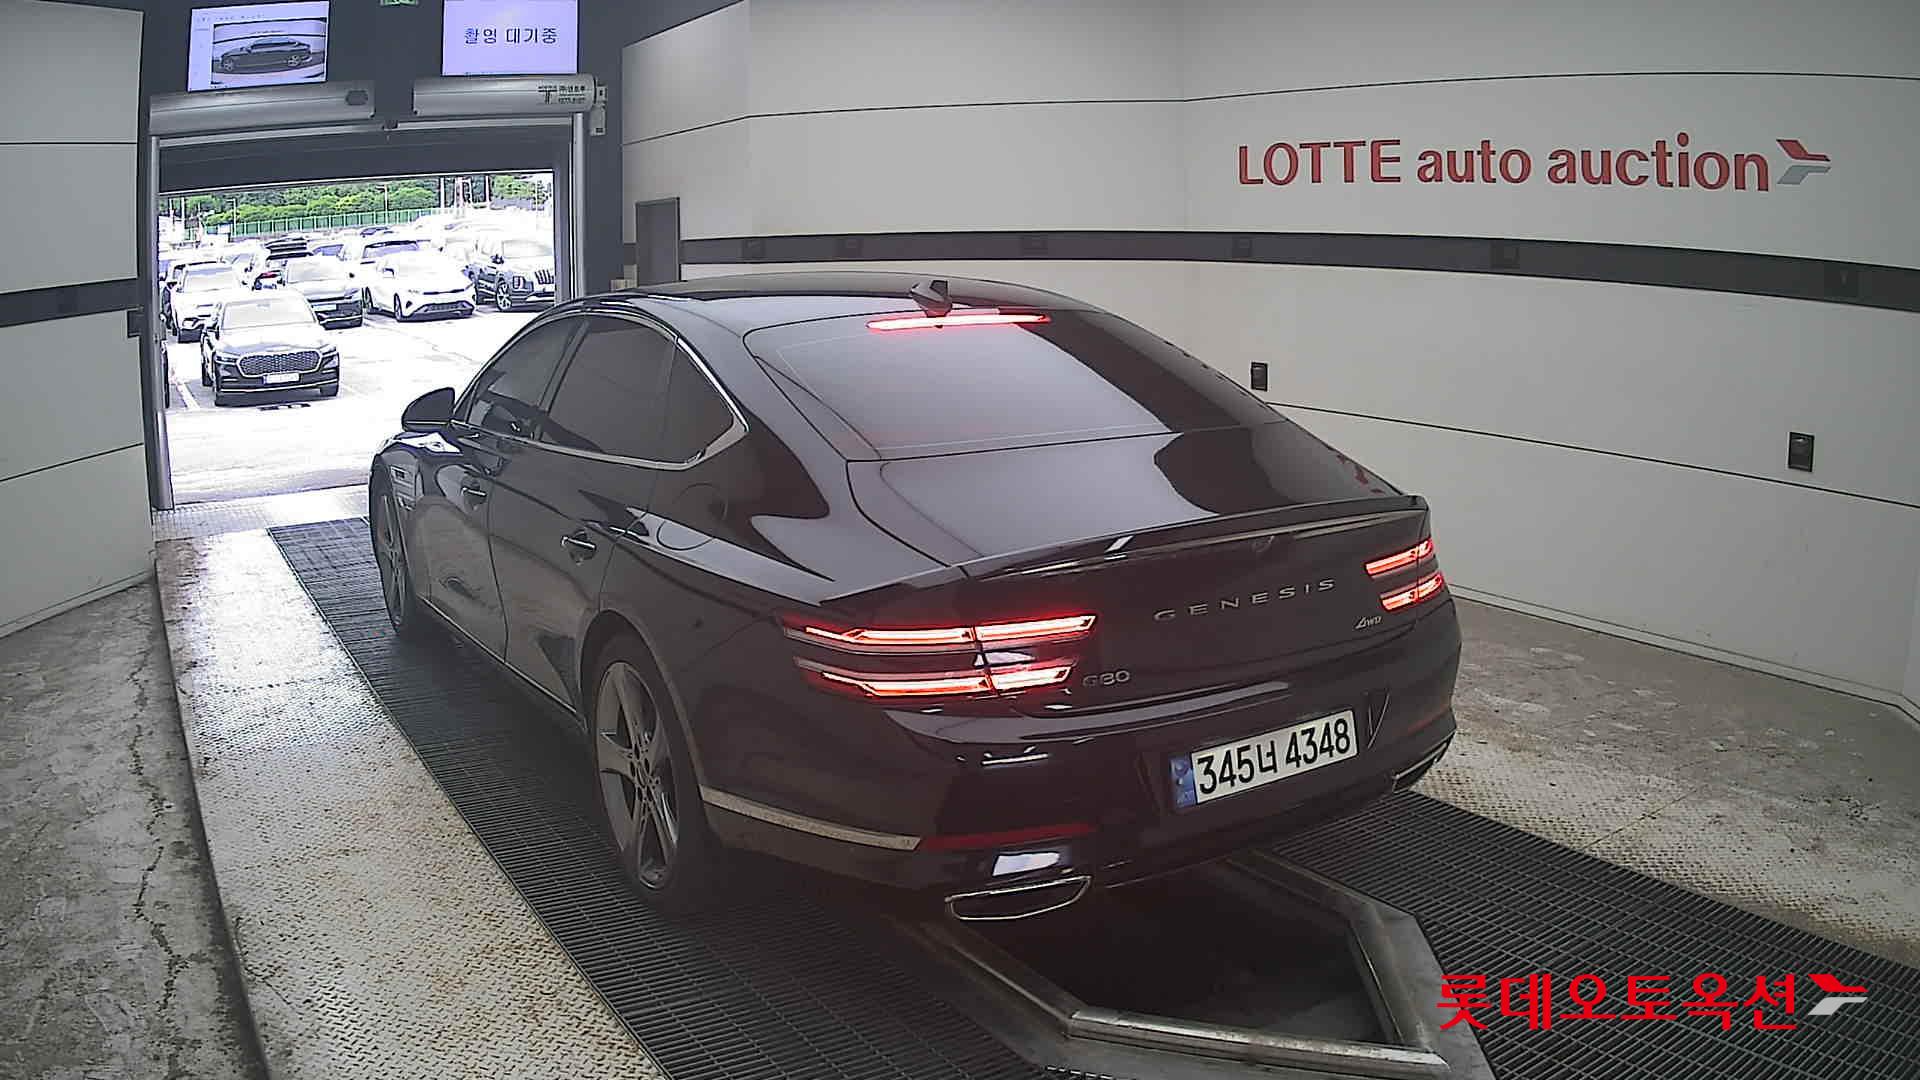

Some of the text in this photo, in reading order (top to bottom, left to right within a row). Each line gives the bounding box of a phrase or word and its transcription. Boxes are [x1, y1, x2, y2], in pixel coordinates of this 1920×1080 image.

[464, 27, 558, 44] 촬영 대기중
[1238, 131, 1770, 192] LOTTE auto auction
[1154, 578, 1336, 621] GENESIS
[1082, 670, 1130, 687] G80
[1197, 718, 1351, 795] 345너 4348
